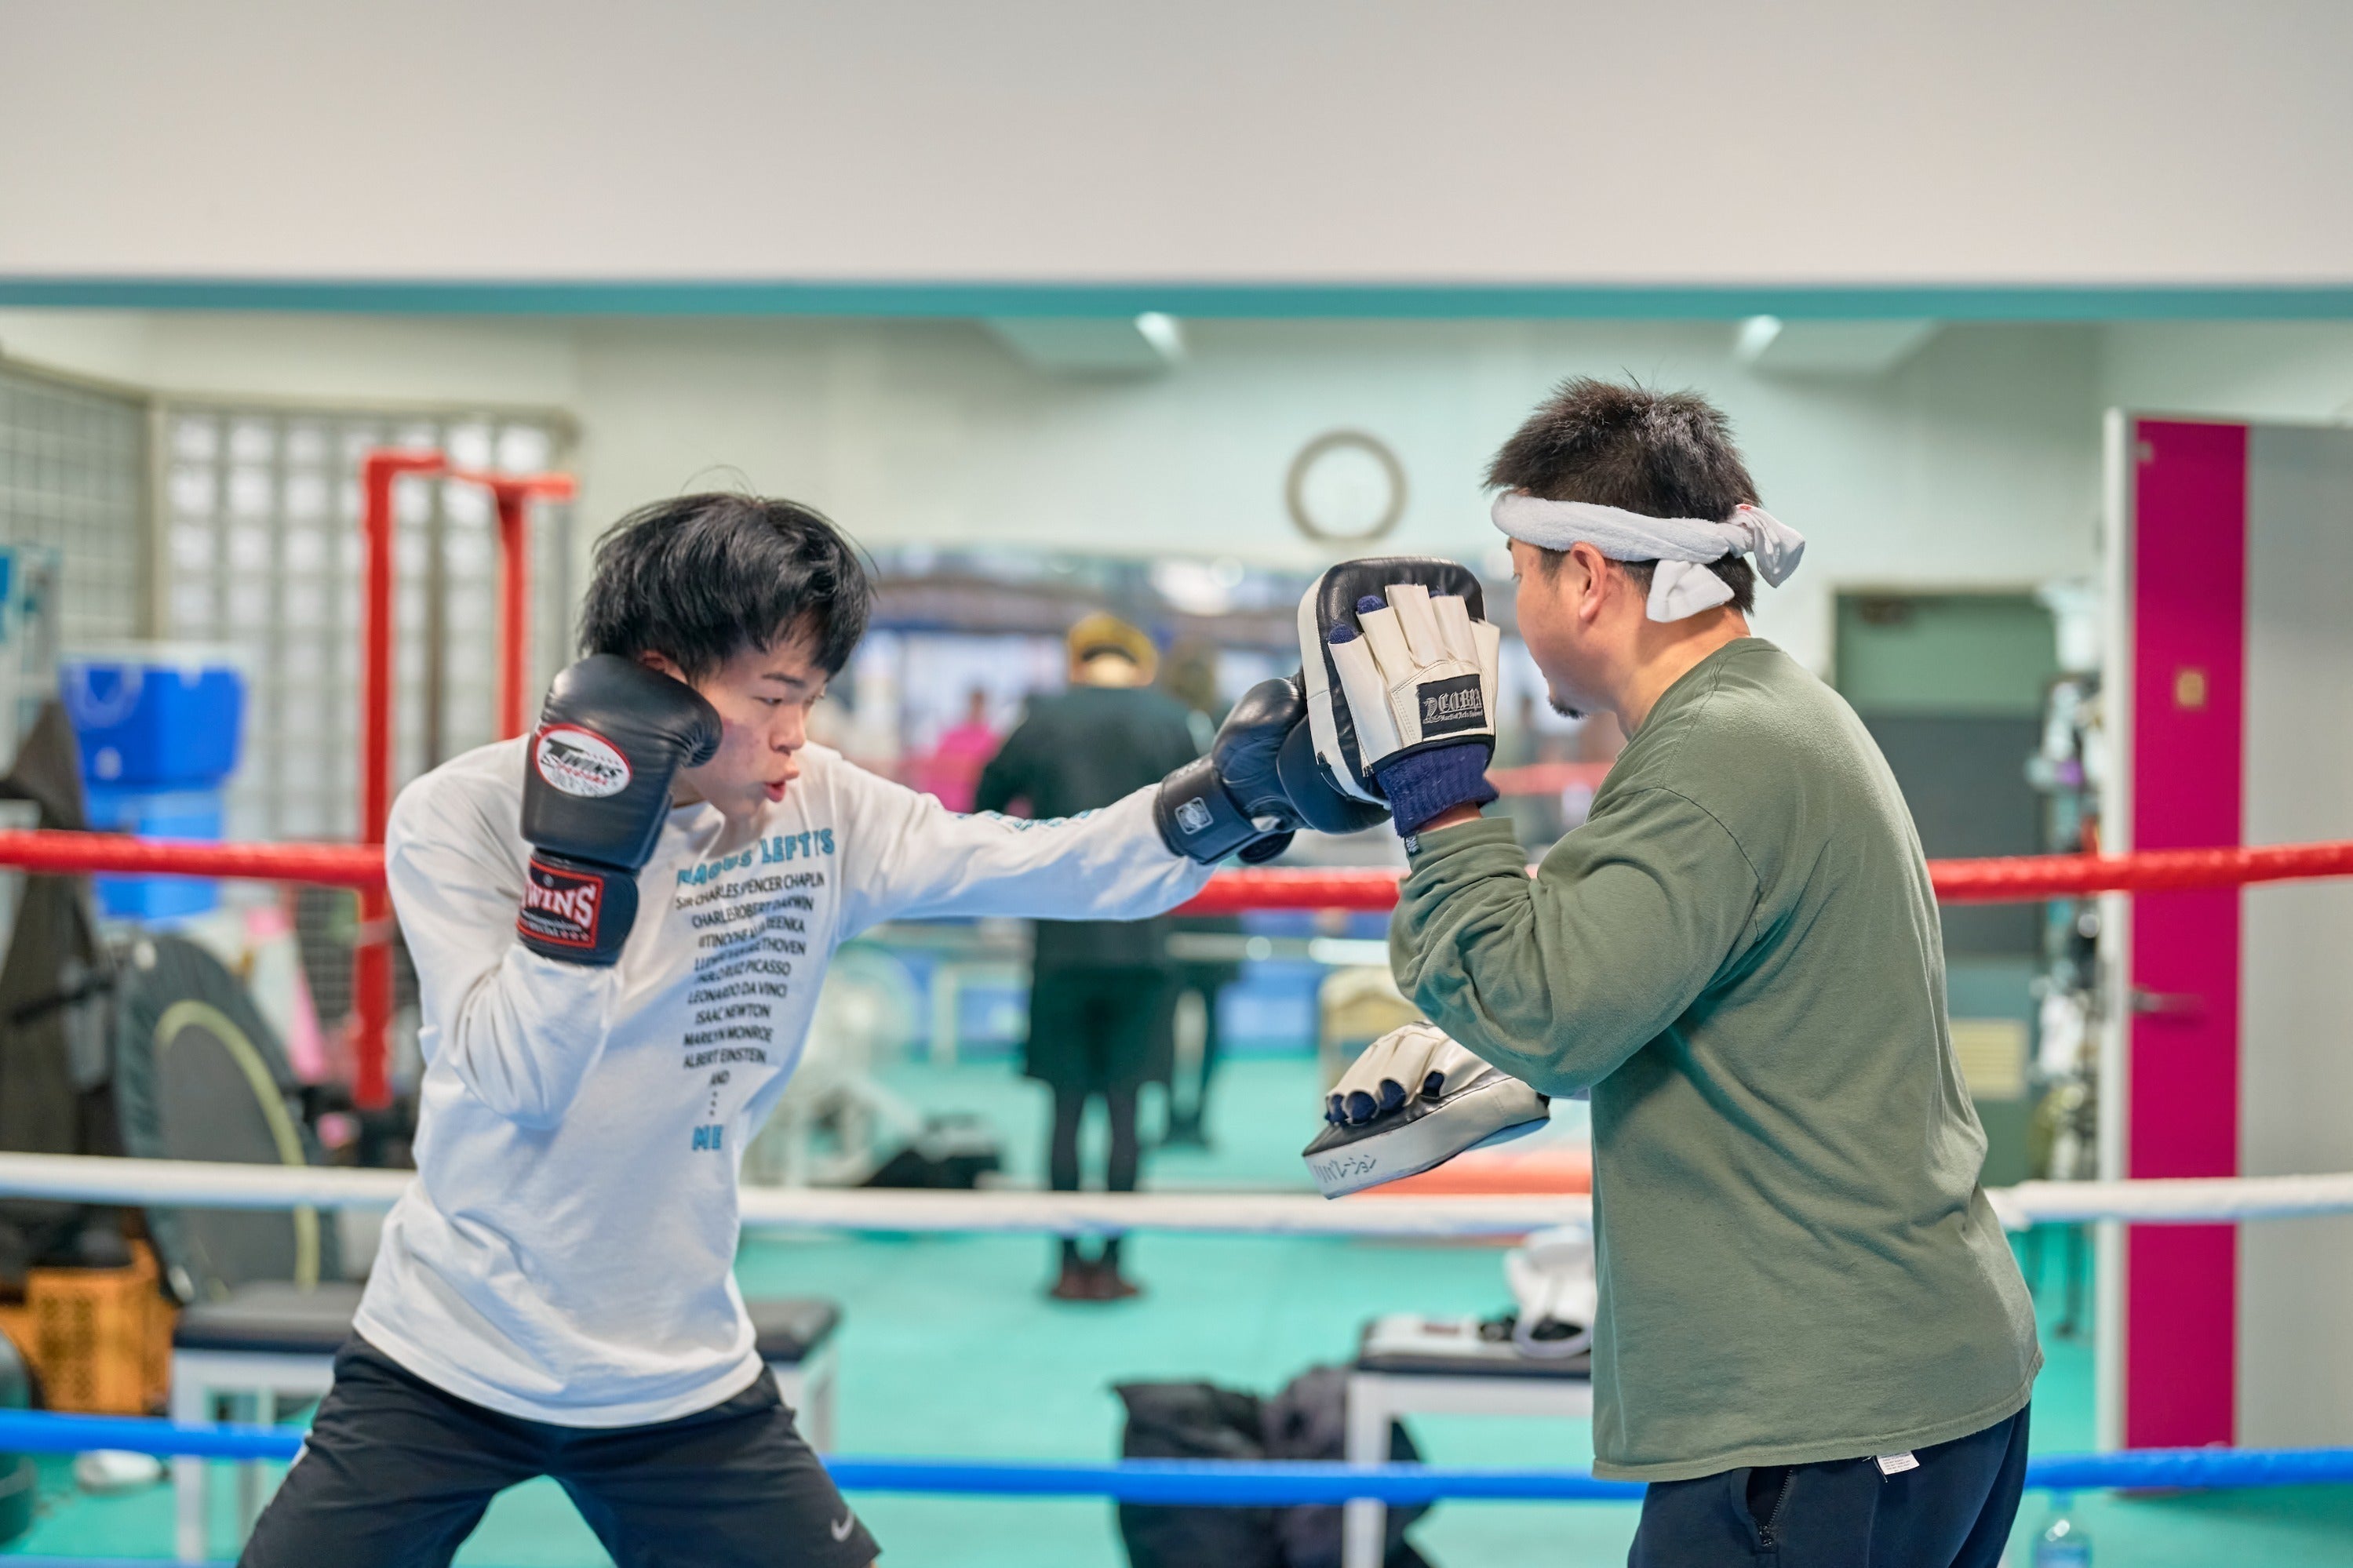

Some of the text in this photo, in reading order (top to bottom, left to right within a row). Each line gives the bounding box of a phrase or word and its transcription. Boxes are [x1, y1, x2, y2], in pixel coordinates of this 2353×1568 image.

[784, 871, 825, 889] CHAPLIN
[745, 958, 792, 977] PICASSO
[741, 980, 756, 996] DA
[758, 981, 788, 999] VINCI
[695, 1002, 770, 1025] ISAAC NEWTON
[727, 1024, 773, 1043] MONROE
[683, 1046, 767, 1069] ALBERT EINSTEIN
[709, 1070, 730, 1086] AND
[691, 1124, 723, 1151] ME
